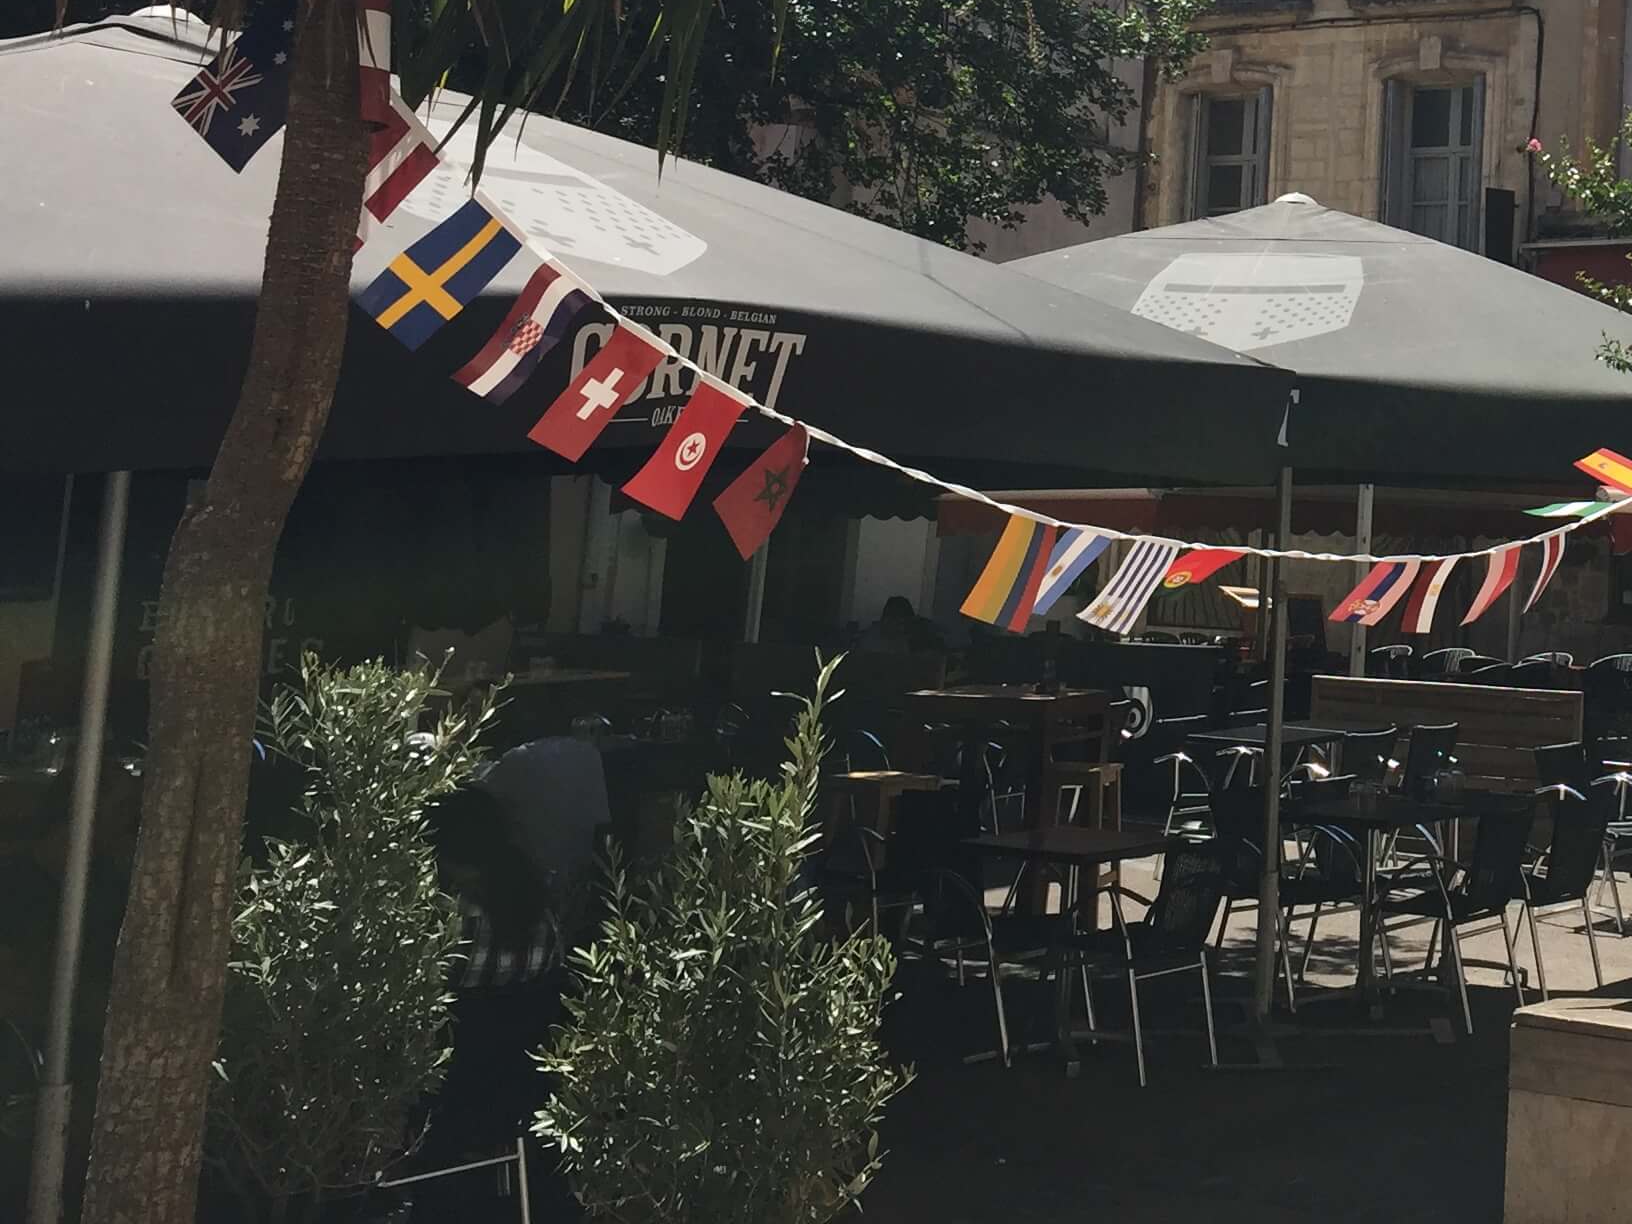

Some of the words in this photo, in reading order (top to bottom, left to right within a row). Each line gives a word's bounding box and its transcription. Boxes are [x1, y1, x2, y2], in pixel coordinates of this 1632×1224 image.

[620, 304, 671, 317] STRONG
[681, 306, 721, 319] BLOND
[729, 309, 777, 325] BELGIAN
[568, 322, 808, 408] CRNET
